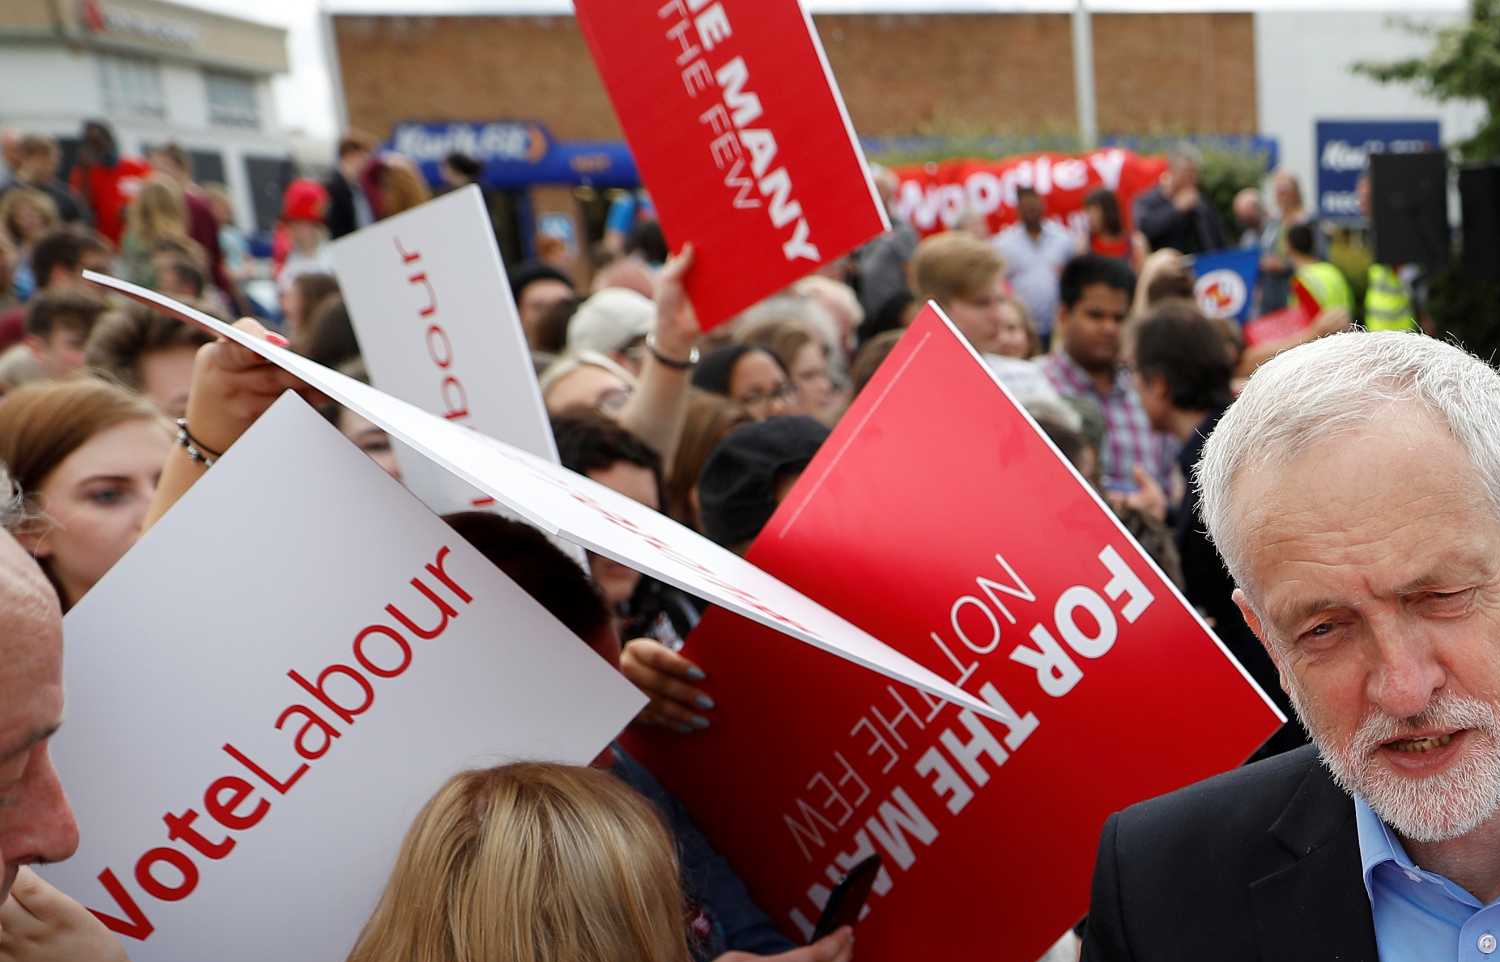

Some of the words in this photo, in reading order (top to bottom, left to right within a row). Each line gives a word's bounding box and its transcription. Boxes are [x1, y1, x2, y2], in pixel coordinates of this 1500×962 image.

[699, 103, 762, 209] FEW
[715, 55, 821, 262] MANY
[931, 553, 1037, 689] NOT
[1010, 544, 1155, 698] FOR
[88, 545, 473, 942] VoteLabour
[851, 685, 950, 774] THE
[914, 681, 1041, 817] THE
[783, 751, 871, 863] FEW
[789, 785, 940, 942] MA
